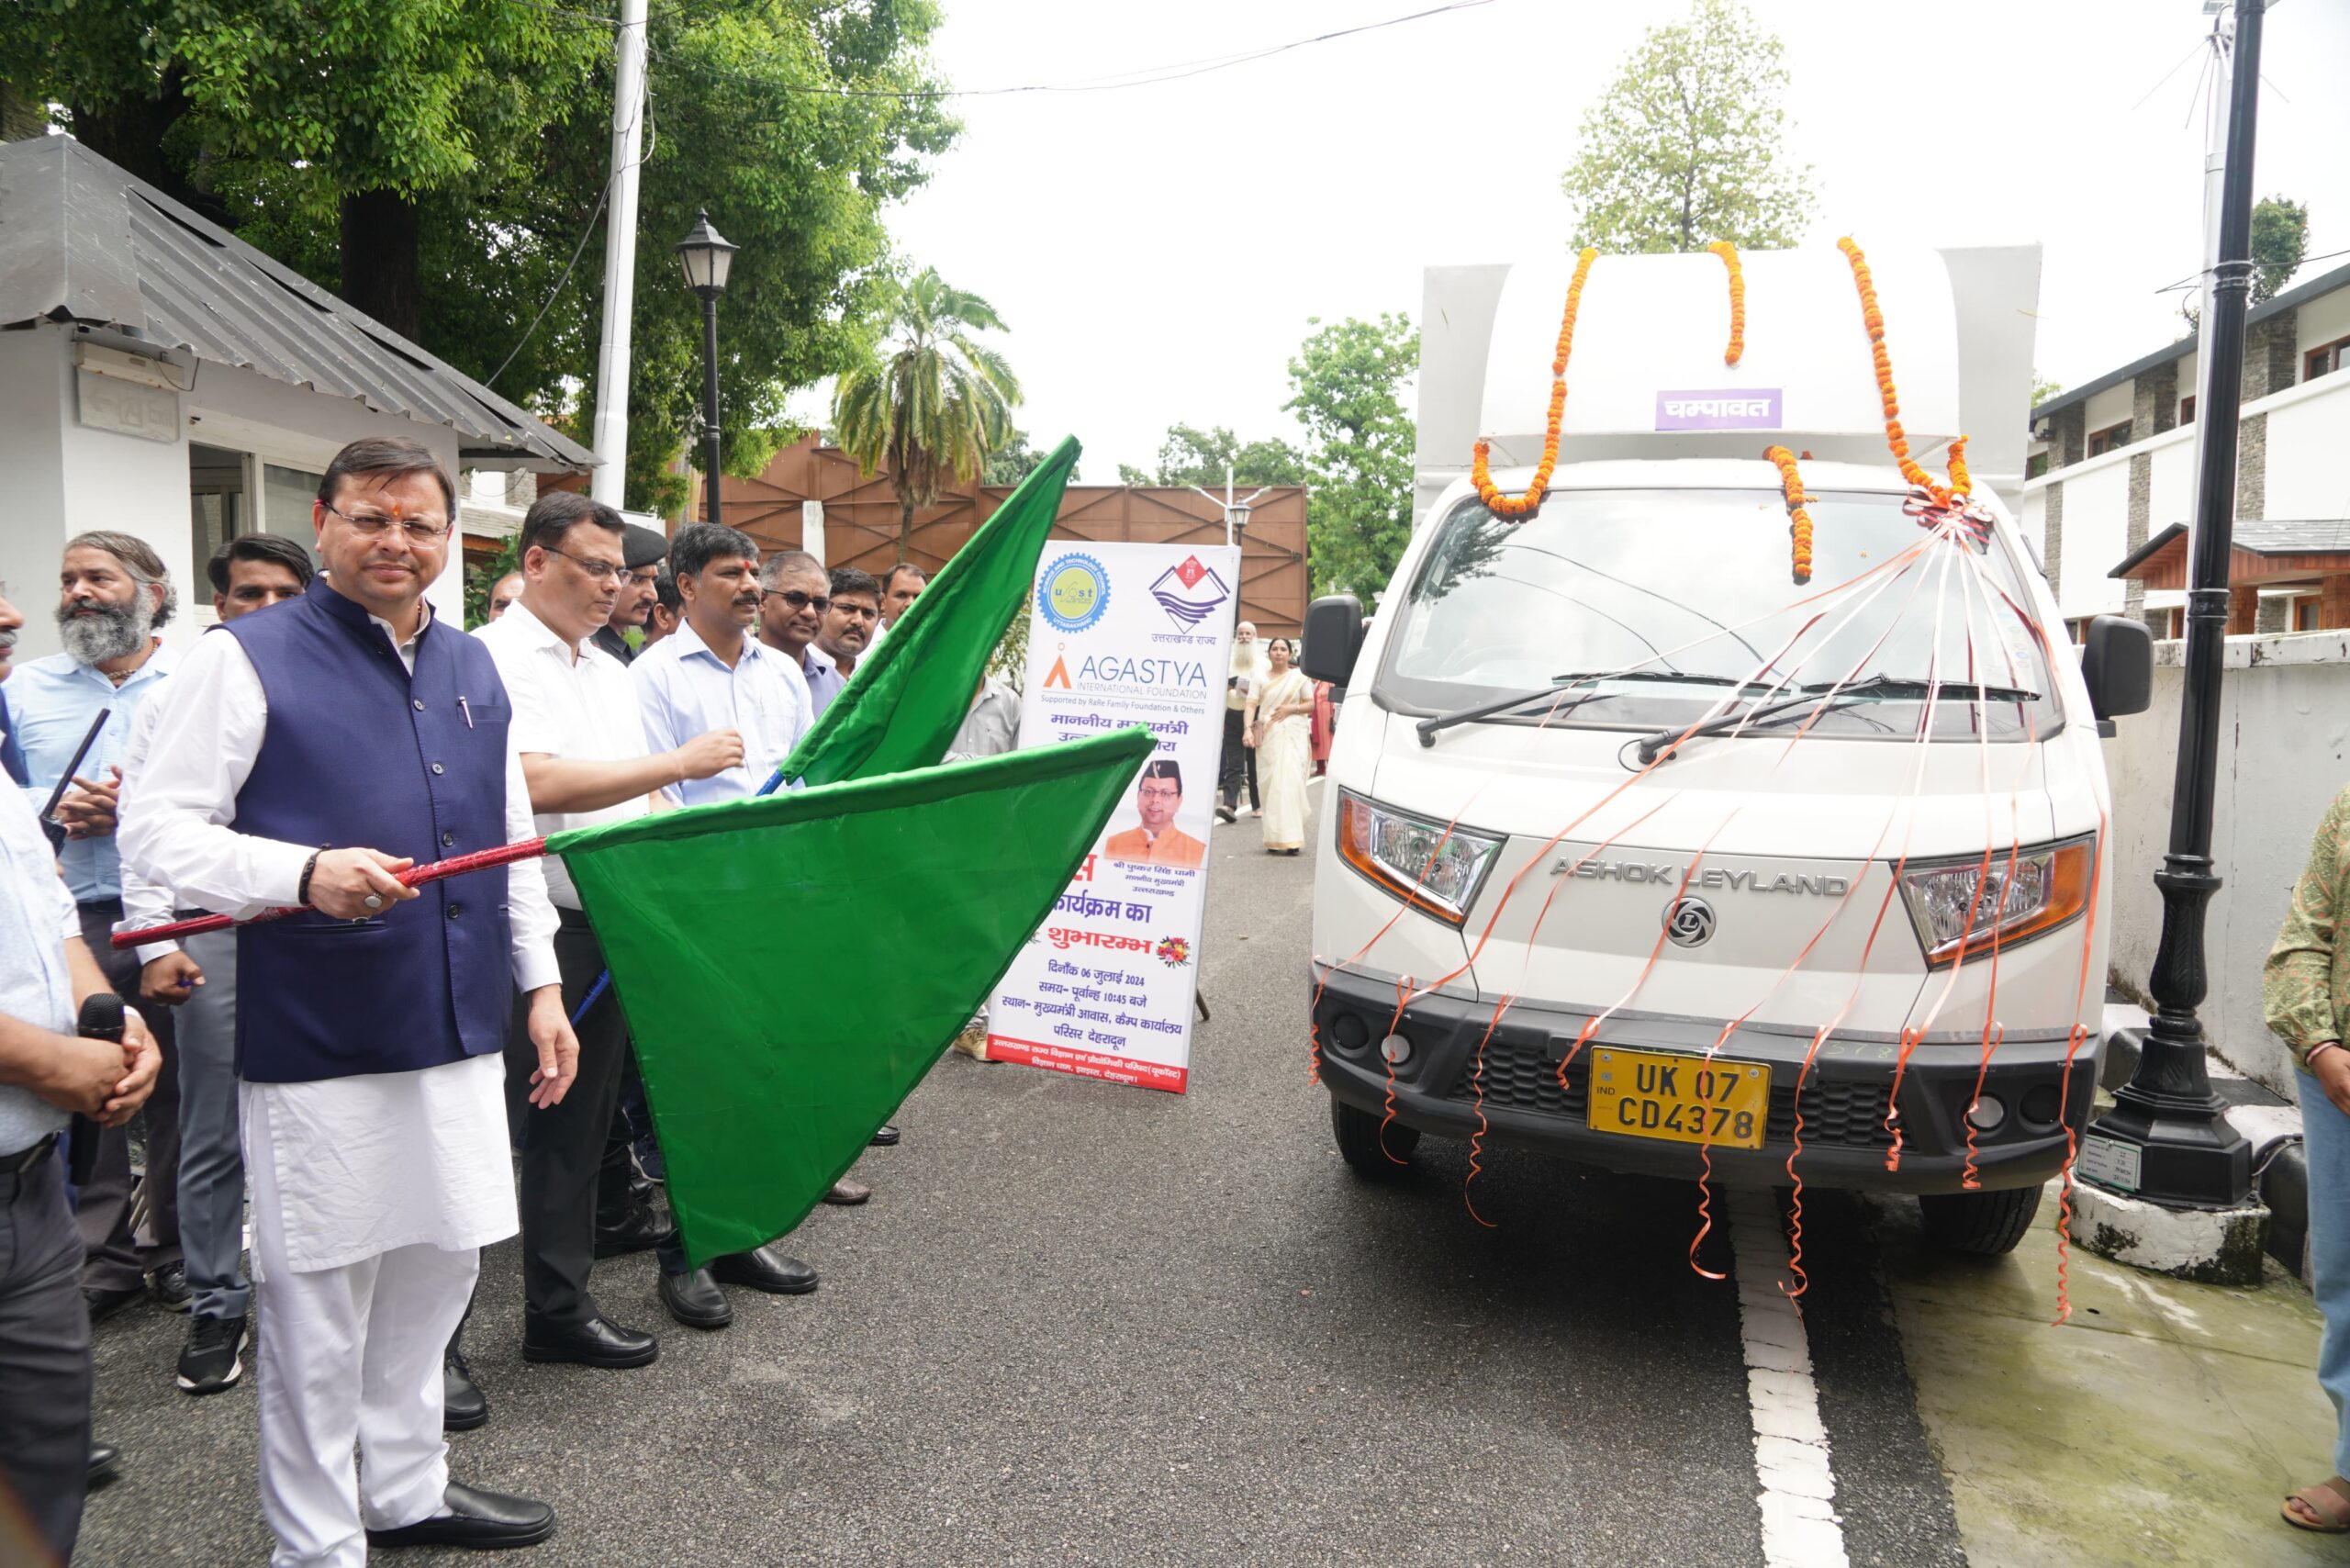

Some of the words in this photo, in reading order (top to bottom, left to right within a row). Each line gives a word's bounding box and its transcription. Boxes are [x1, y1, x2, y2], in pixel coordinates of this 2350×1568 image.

[1664, 398, 1772, 419] चम्पावत
[1065, 557, 1098, 572] TECHNOLOGY
[1053, 617, 1092, 629] UTTARAKHAND
[1151, 633, 1193, 645] उत्तराखण्ड
[1196, 635, 1217, 646] राज्य
[1079, 655, 1207, 688] AGASTYA
[1077, 682, 1144, 696] INTERNATIONAL
[1147, 687, 1207, 700] FOUNDATION
[1041, 694, 1077, 705] Supported
[1078, 698, 1087, 707] by
[1089, 699, 1105, 707] RaRe
[1106, 700, 1130, 710] Family
[1130, 701, 1171, 711] Foundation
[1172, 704, 1179, 712] &
[1180, 705, 1205, 715] Others
[1050, 713, 1113, 728] माननीय
[1125, 874, 1152, 882] माननीय
[1154, 878, 1185, 887] मुख्यमंत्री
[1127, 864, 1152, 873] पुष्कर
[1154, 865, 1172, 875] सिंह
[1174, 869, 1196, 878] धामी
[1550, 856, 1673, 885] ASHOK
[1682, 866, 1850, 896] LEYLAND
[1132, 885, 1175, 897] उत्तराखण्ड
[1125, 902, 1153, 924] का
[1047, 927, 1154, 955] शुभारम्भ
[1048, 959, 1079, 976] दिनाँक
[1080, 968, 1091, 979] 06
[1093, 969, 1124, 985] जुलाई
[1125, 975, 1146, 987] 2024
[1038, 981, 1069, 994] समय-
[1072, 985, 1101, 1002] पूर्वान्ह
[1103, 992, 1126, 1004] 10:45
[1129, 994, 1147, 1008] बजे
[1002, 995, 1031, 1009] स्थान-
[1034, 1001, 1076, 1017] मुख्यमंत्री
[1078, 1008, 1112, 1025] आवास,
[1114, 1012, 1138, 1028] कैम्प
[1140, 1019, 1183, 1036] कार्यालय
[1053, 1023, 1083, 1040] परिसर
[1088, 1028, 1126, 1051] देहरादून
[992, 1038, 1030, 1052] उत्तराखण्ड
[1031, 1047, 1049, 1055] राज्य
[1050, 1047, 1074, 1059] विज्ञान
[1075, 1053, 1087, 1061] एवं
[1032, 1056, 1056, 1068] विज्ञान
[1596, 1086, 1616, 1096] IND
[1637, 1063, 1679, 1097] UK
[1695, 1070, 1740, 1103] 07
[1618, 1096, 1754, 1139] CD4378
